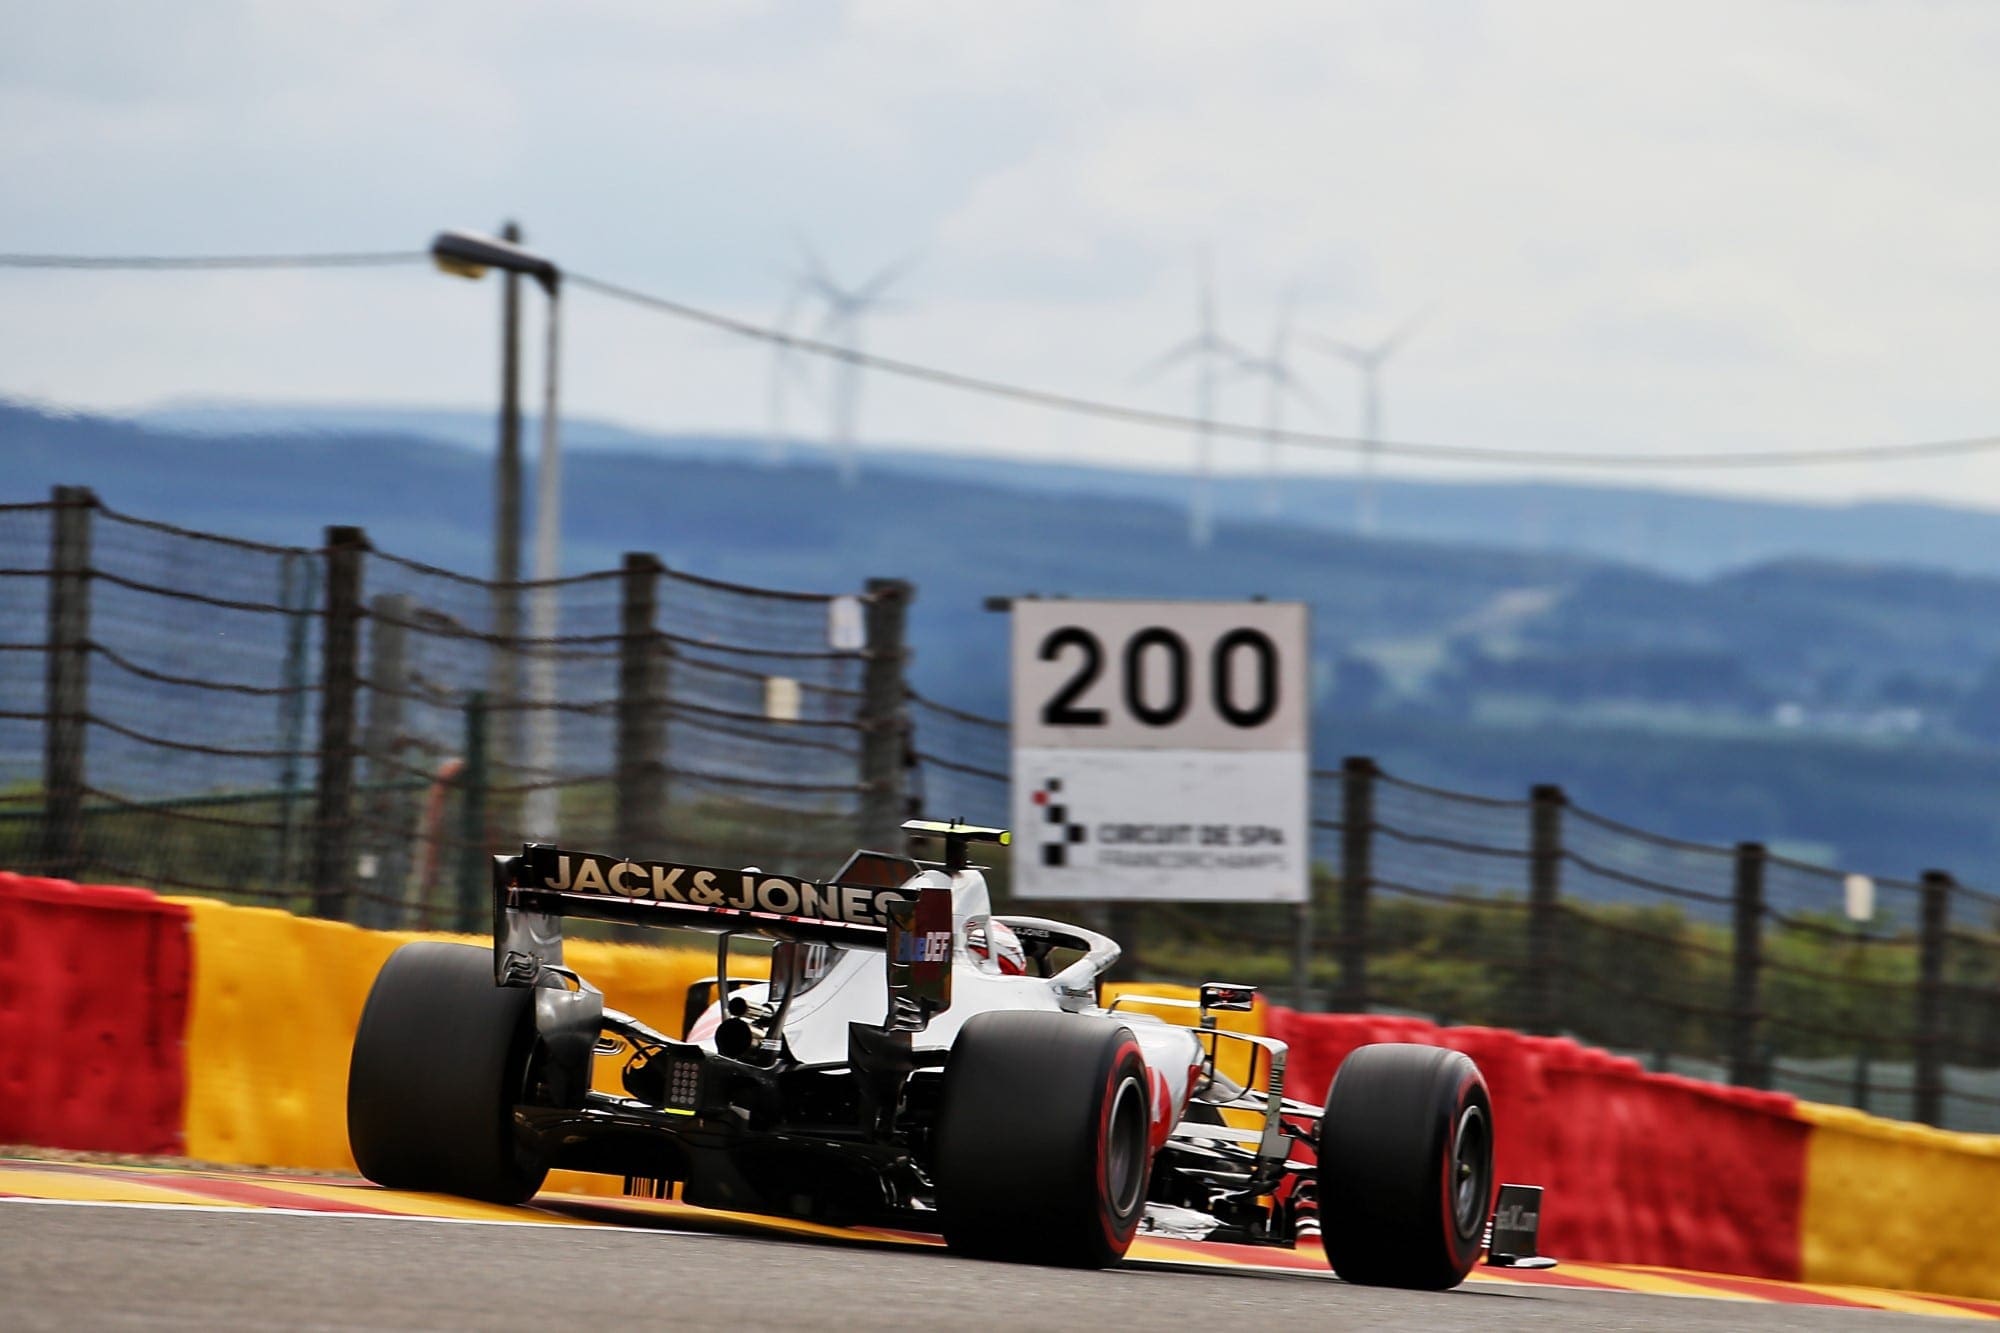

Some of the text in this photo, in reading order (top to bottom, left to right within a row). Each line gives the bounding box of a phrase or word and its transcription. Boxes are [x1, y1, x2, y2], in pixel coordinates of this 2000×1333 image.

[1037, 625, 1280, 729] 200
[1098, 823, 1284, 847] CIRCUIT DE SPA
